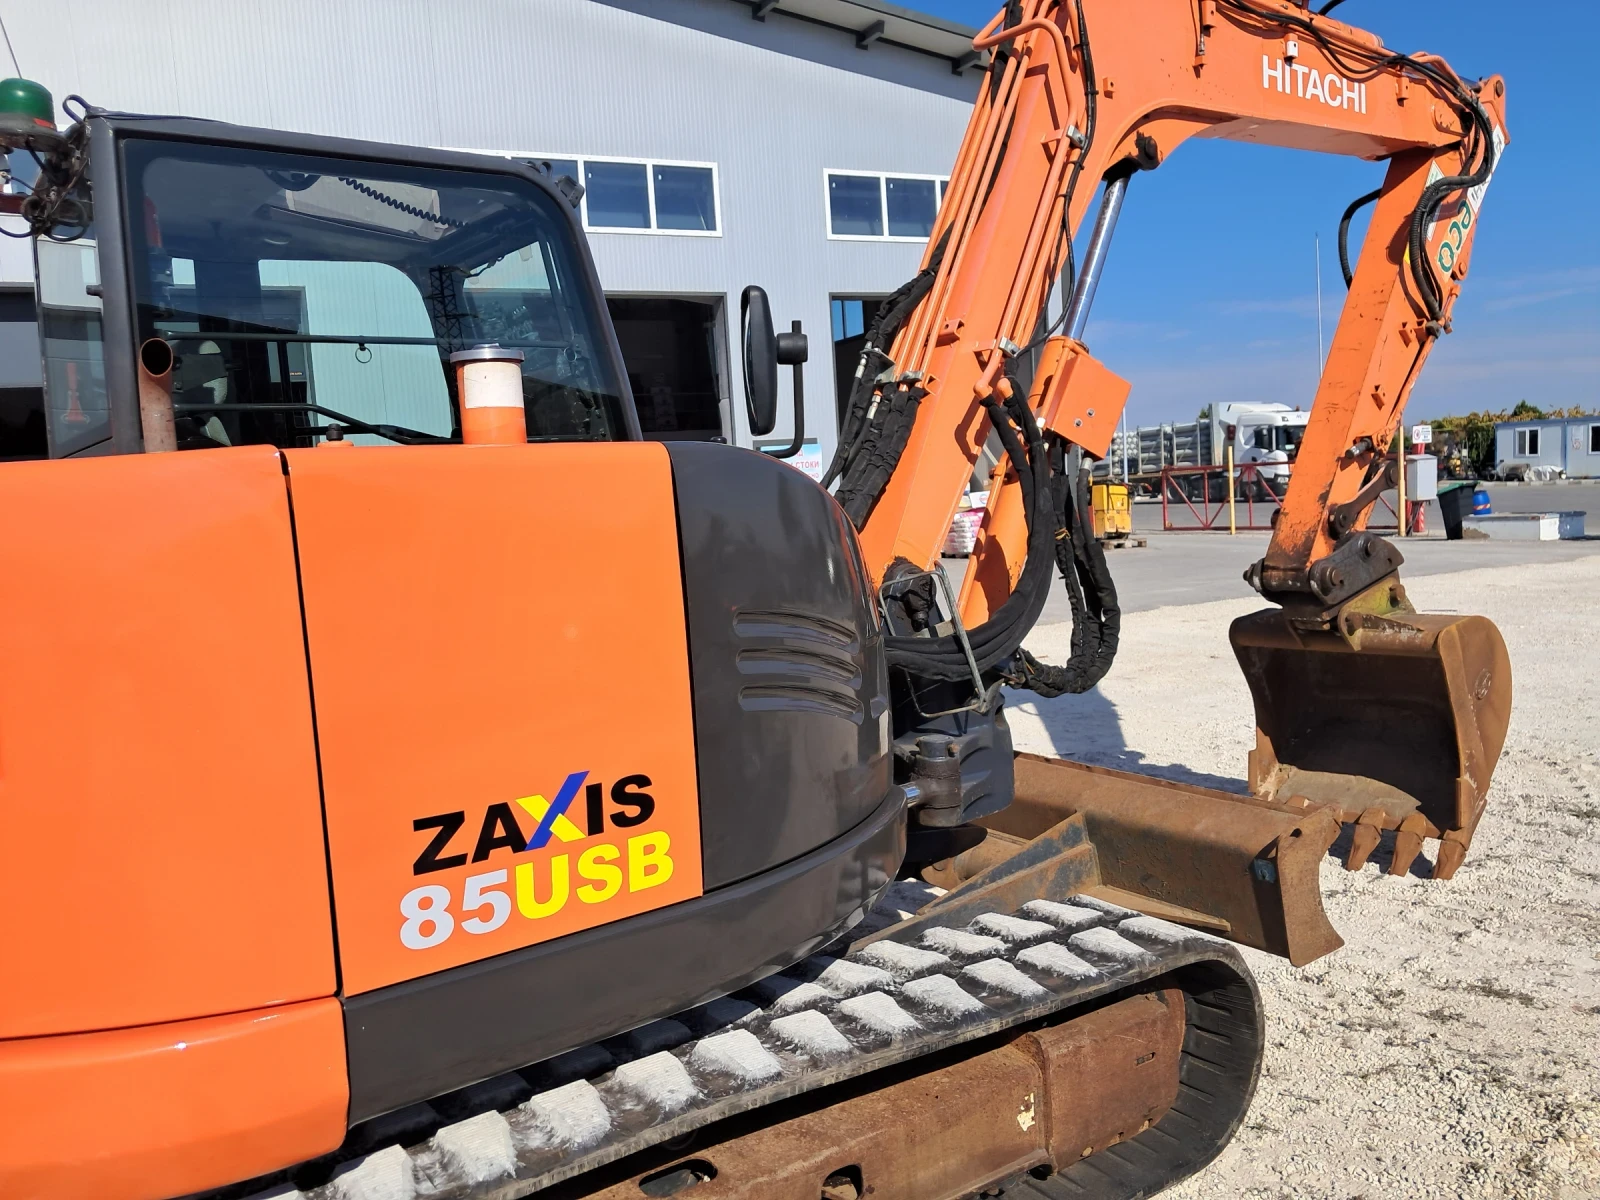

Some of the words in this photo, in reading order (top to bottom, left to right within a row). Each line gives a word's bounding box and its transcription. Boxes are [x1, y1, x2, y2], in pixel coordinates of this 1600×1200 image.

[1262, 54, 1366, 115] HITACHI
[412, 770, 656, 876] ZAXIS
[399, 830, 674, 950] 85USB
